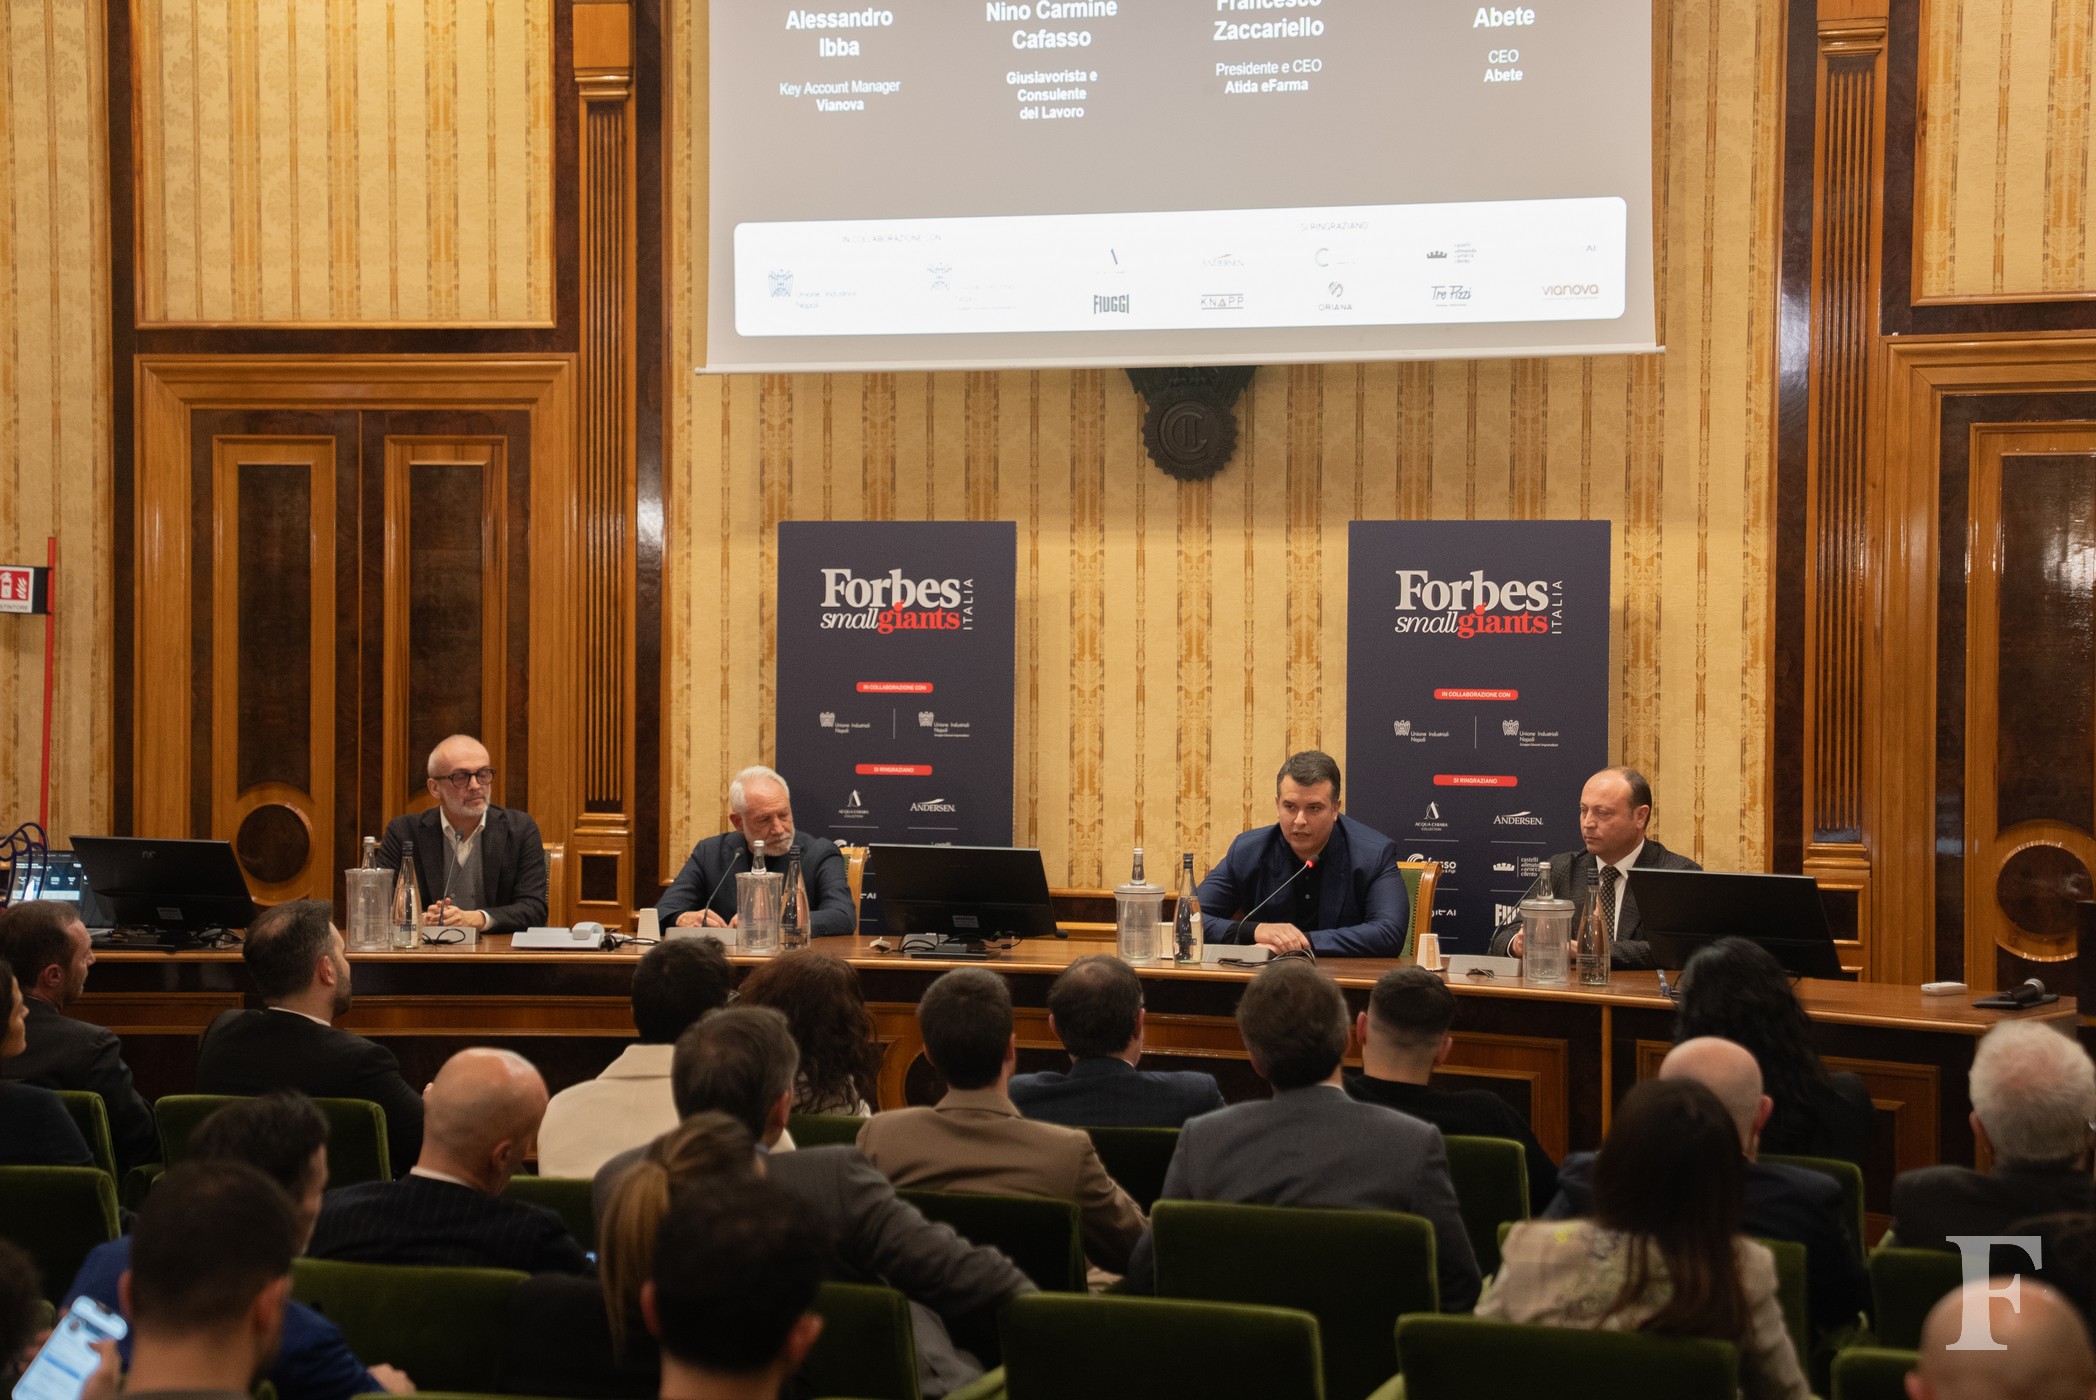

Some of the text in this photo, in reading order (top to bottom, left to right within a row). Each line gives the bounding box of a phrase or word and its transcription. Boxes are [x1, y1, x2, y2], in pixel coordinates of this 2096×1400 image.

[785, 8, 894, 30] Alessandro
[986, 0, 1118, 22] Nino Carmine
[1473, 6, 1536, 28] Abete
[1213, 17, 1325, 41] Zaccariello
[819, 37, 860, 57] Ibba
[1012, 29, 1092, 49] Cafasso
[1488, 49, 1519, 64] CEO
[1006, 69, 1098, 85] Giuslavorista e
[1216, 58, 1322, 77] Presidente e CEO
[1484, 67, 1523, 83] Abete
[779, 78, 900, 98] Key Account Manager
[1017, 87, 1087, 102] Consulente
[1224, 77, 1308, 94] Atida eFarma
[816, 98, 864, 112] Vianova
[1020, 105, 1084, 120] del Lavoro
[1541, 284, 1599, 296] vianova
[1093, 294, 1130, 314] FIUGGI
[1319, 303, 1353, 311] ORIANA
[820, 568, 961, 608] Forbes
[1395, 570, 1549, 611] Forbes
[962, 578, 974, 631] ITALIA
[1552, 580, 1563, 635] ITALIA
[870, 683, 914, 691] COLLABORAZIONE
[1448, 690, 1497, 698] COLLABORAZIONE
